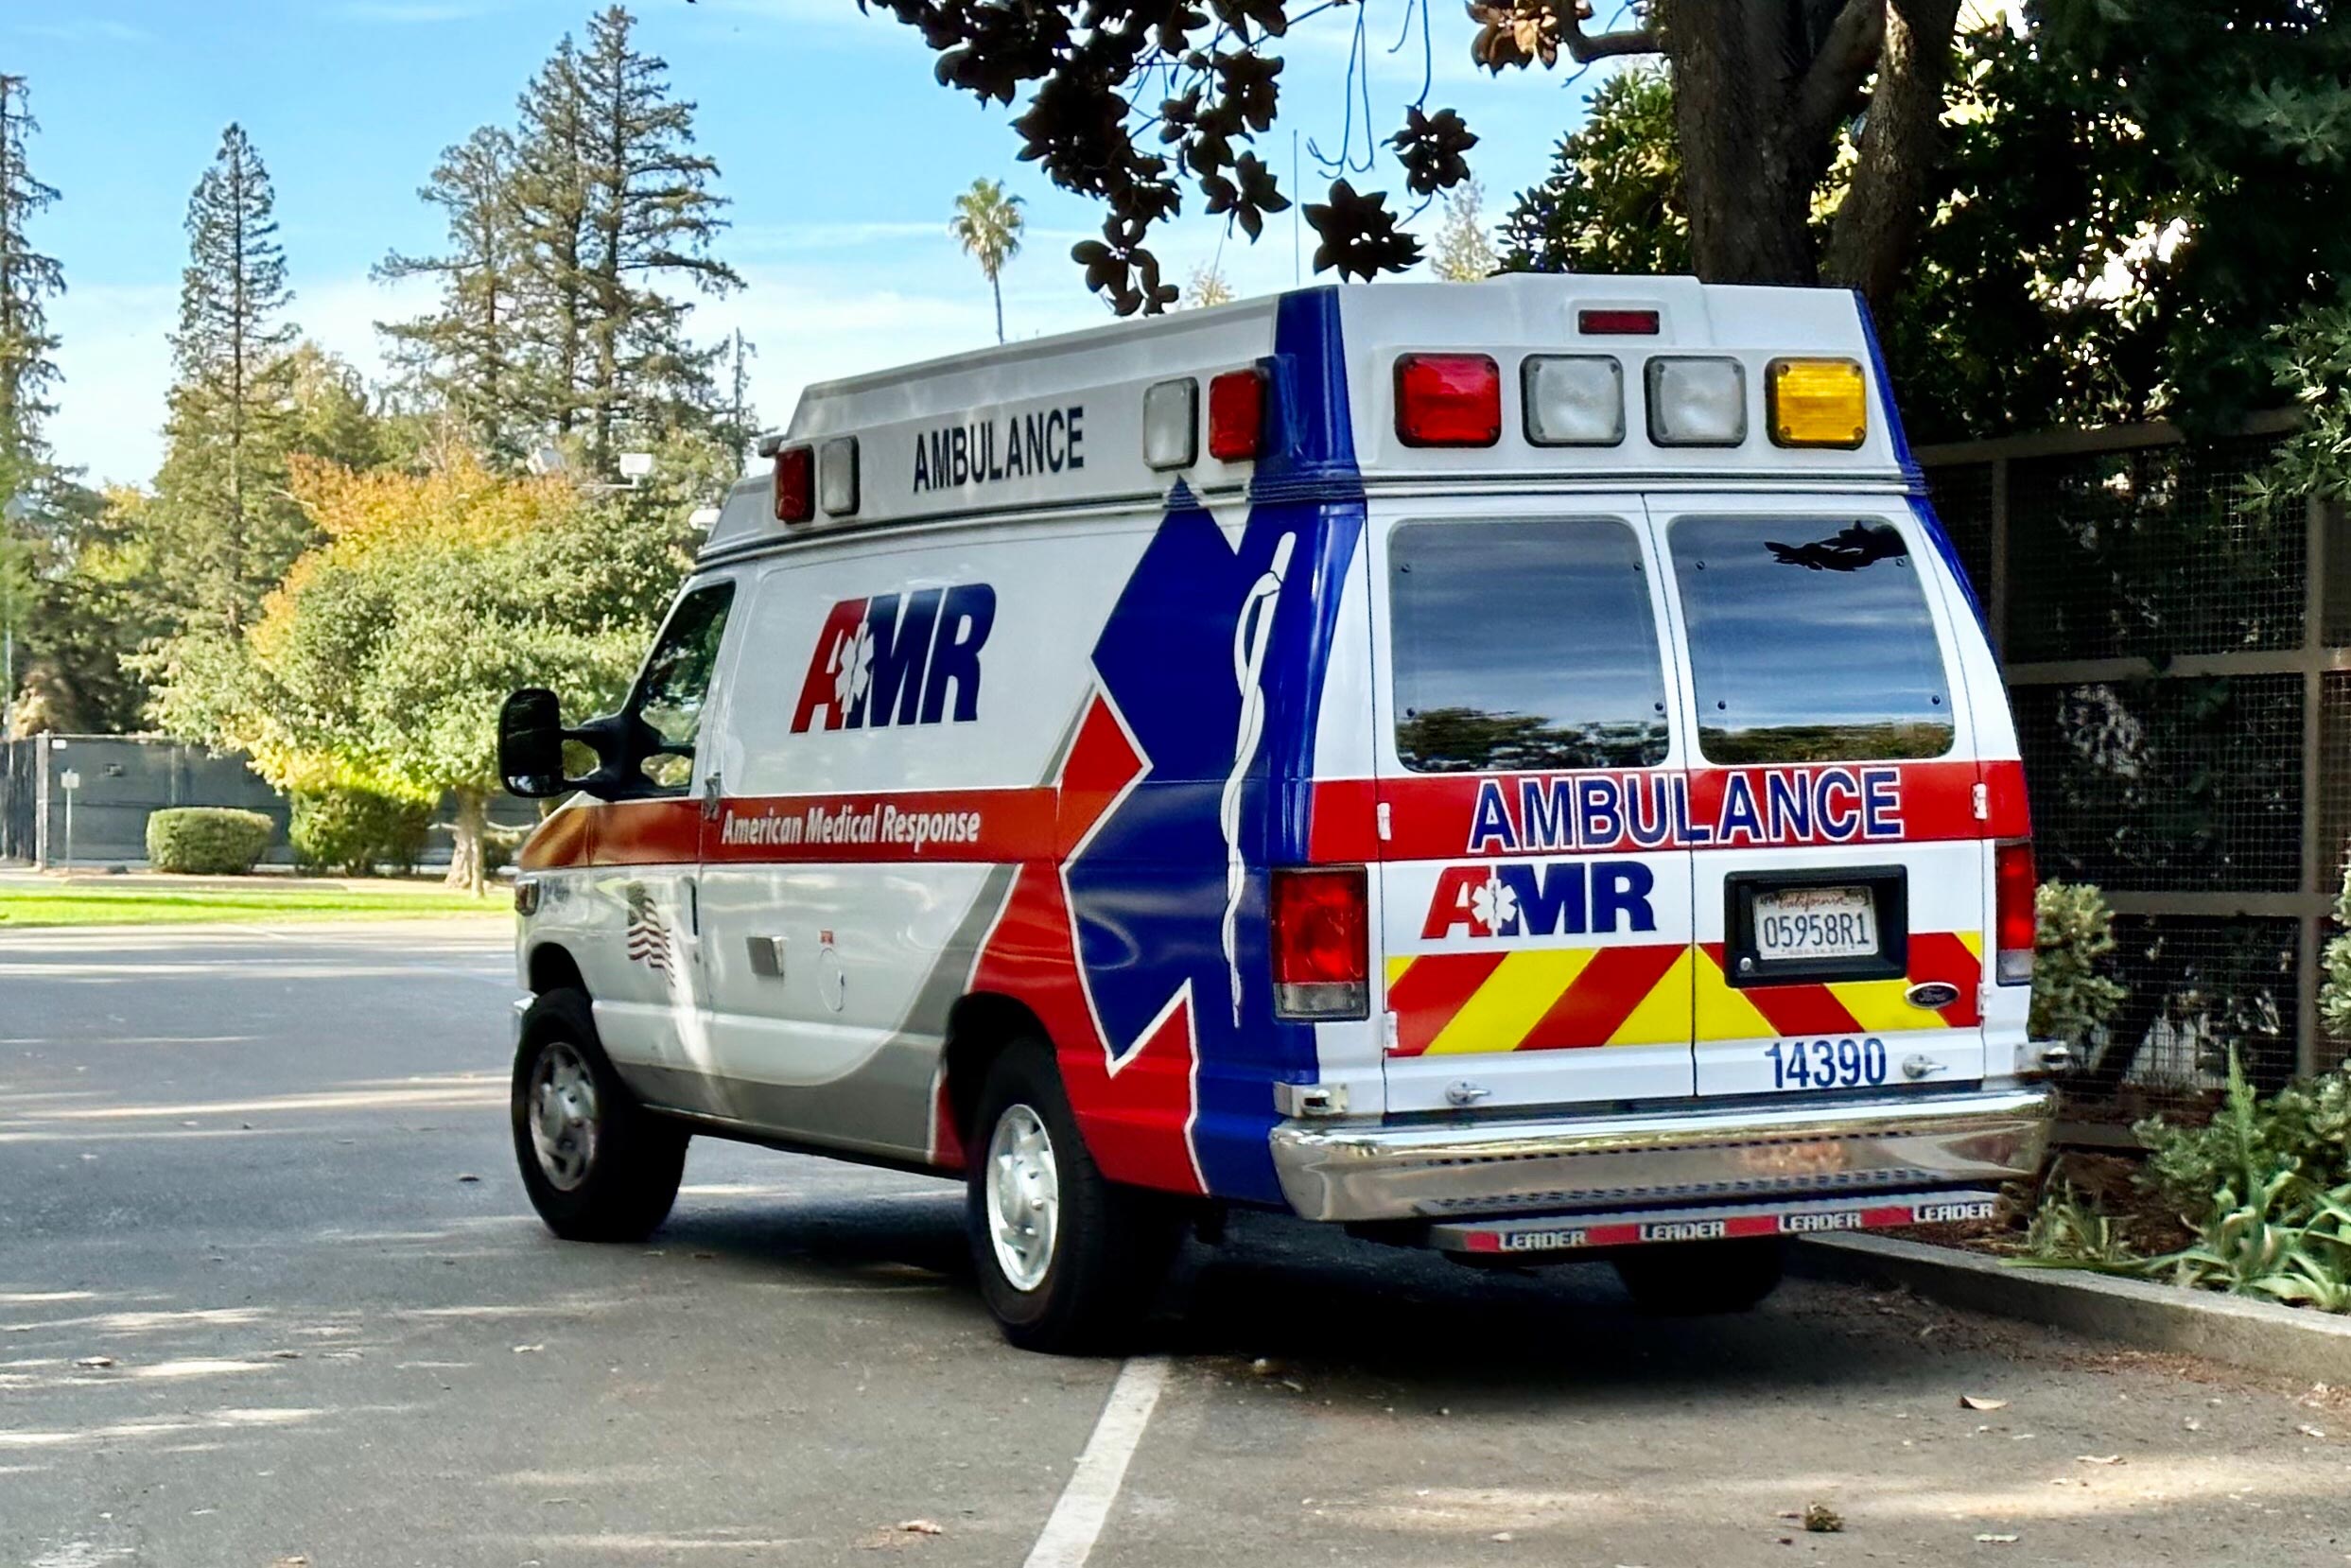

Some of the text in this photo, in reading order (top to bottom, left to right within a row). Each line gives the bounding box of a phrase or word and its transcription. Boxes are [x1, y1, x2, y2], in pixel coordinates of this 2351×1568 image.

[913, 406, 1085, 494] AMBULANCE
[789, 583, 997, 734] AMR
[721, 803, 982, 853] American Medical Response
[1466, 767, 1906, 853] AMBULANCE
[1420, 861, 1657, 940] AMR
[1777, 891, 1848, 913] California
[1764, 913, 1871, 949] 05958R1
[1764, 1037, 1887, 1089] 14390
[1498, 1202, 1994, 1251] LEADER LEADER LEADER LEADER
